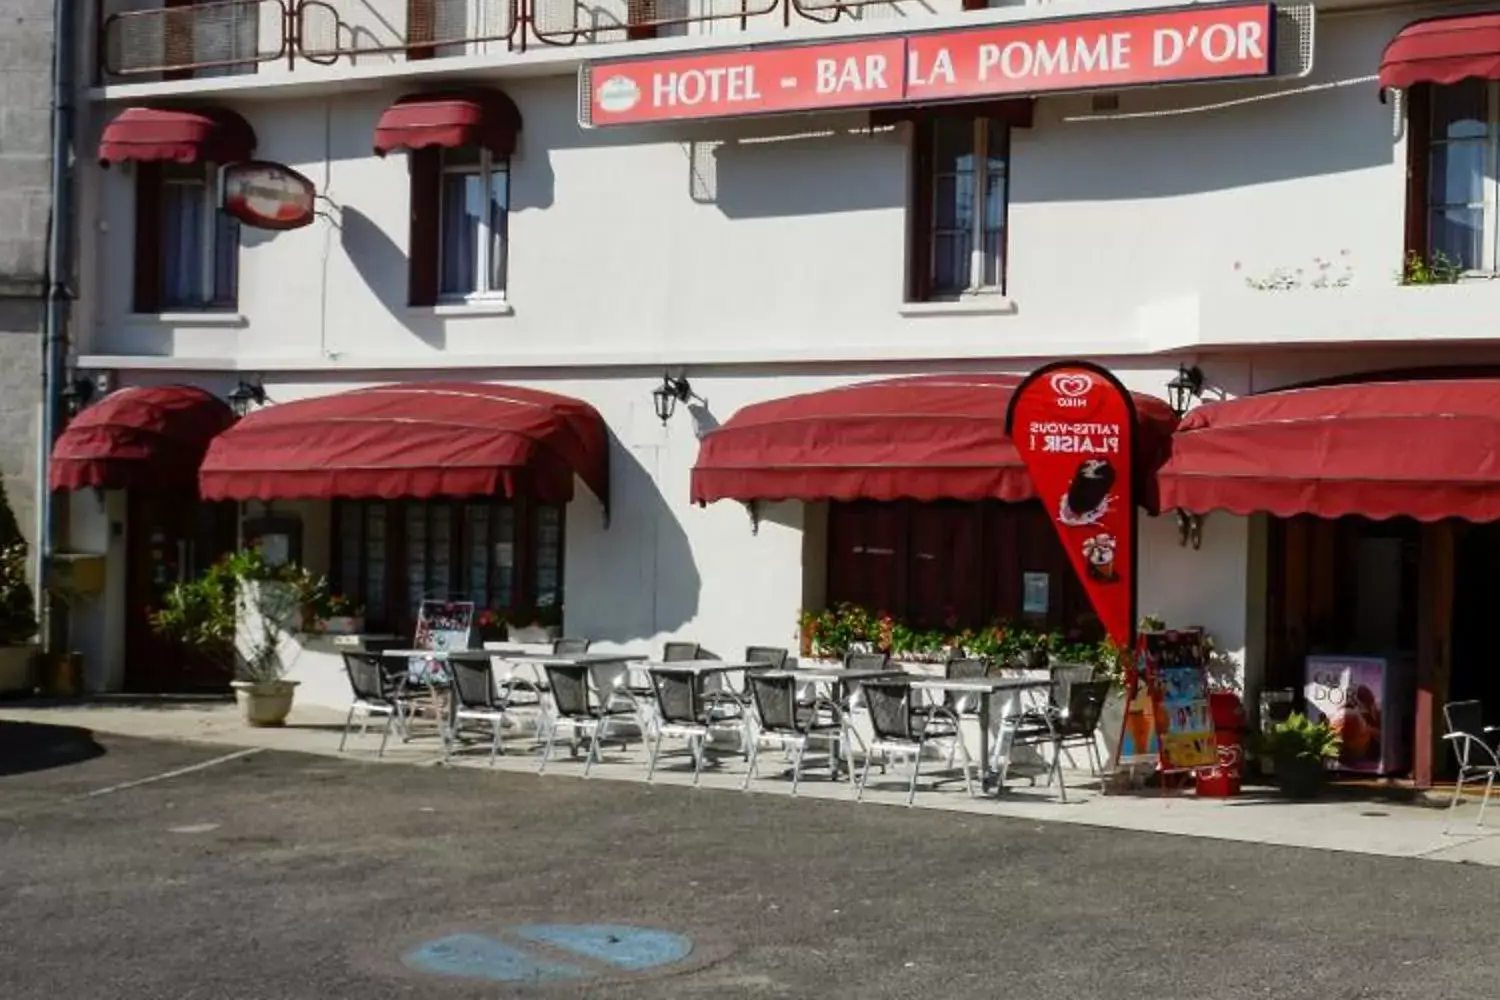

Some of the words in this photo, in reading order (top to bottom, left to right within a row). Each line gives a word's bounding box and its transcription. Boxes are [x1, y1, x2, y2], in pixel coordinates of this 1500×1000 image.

[653, 64, 761, 107] HOTEL
[815, 54, 888, 94] BAR
[908, 48, 956, 86] LA
[978, 32, 1132, 82] POMME
[1152, 20, 1264, 68] D'OR
